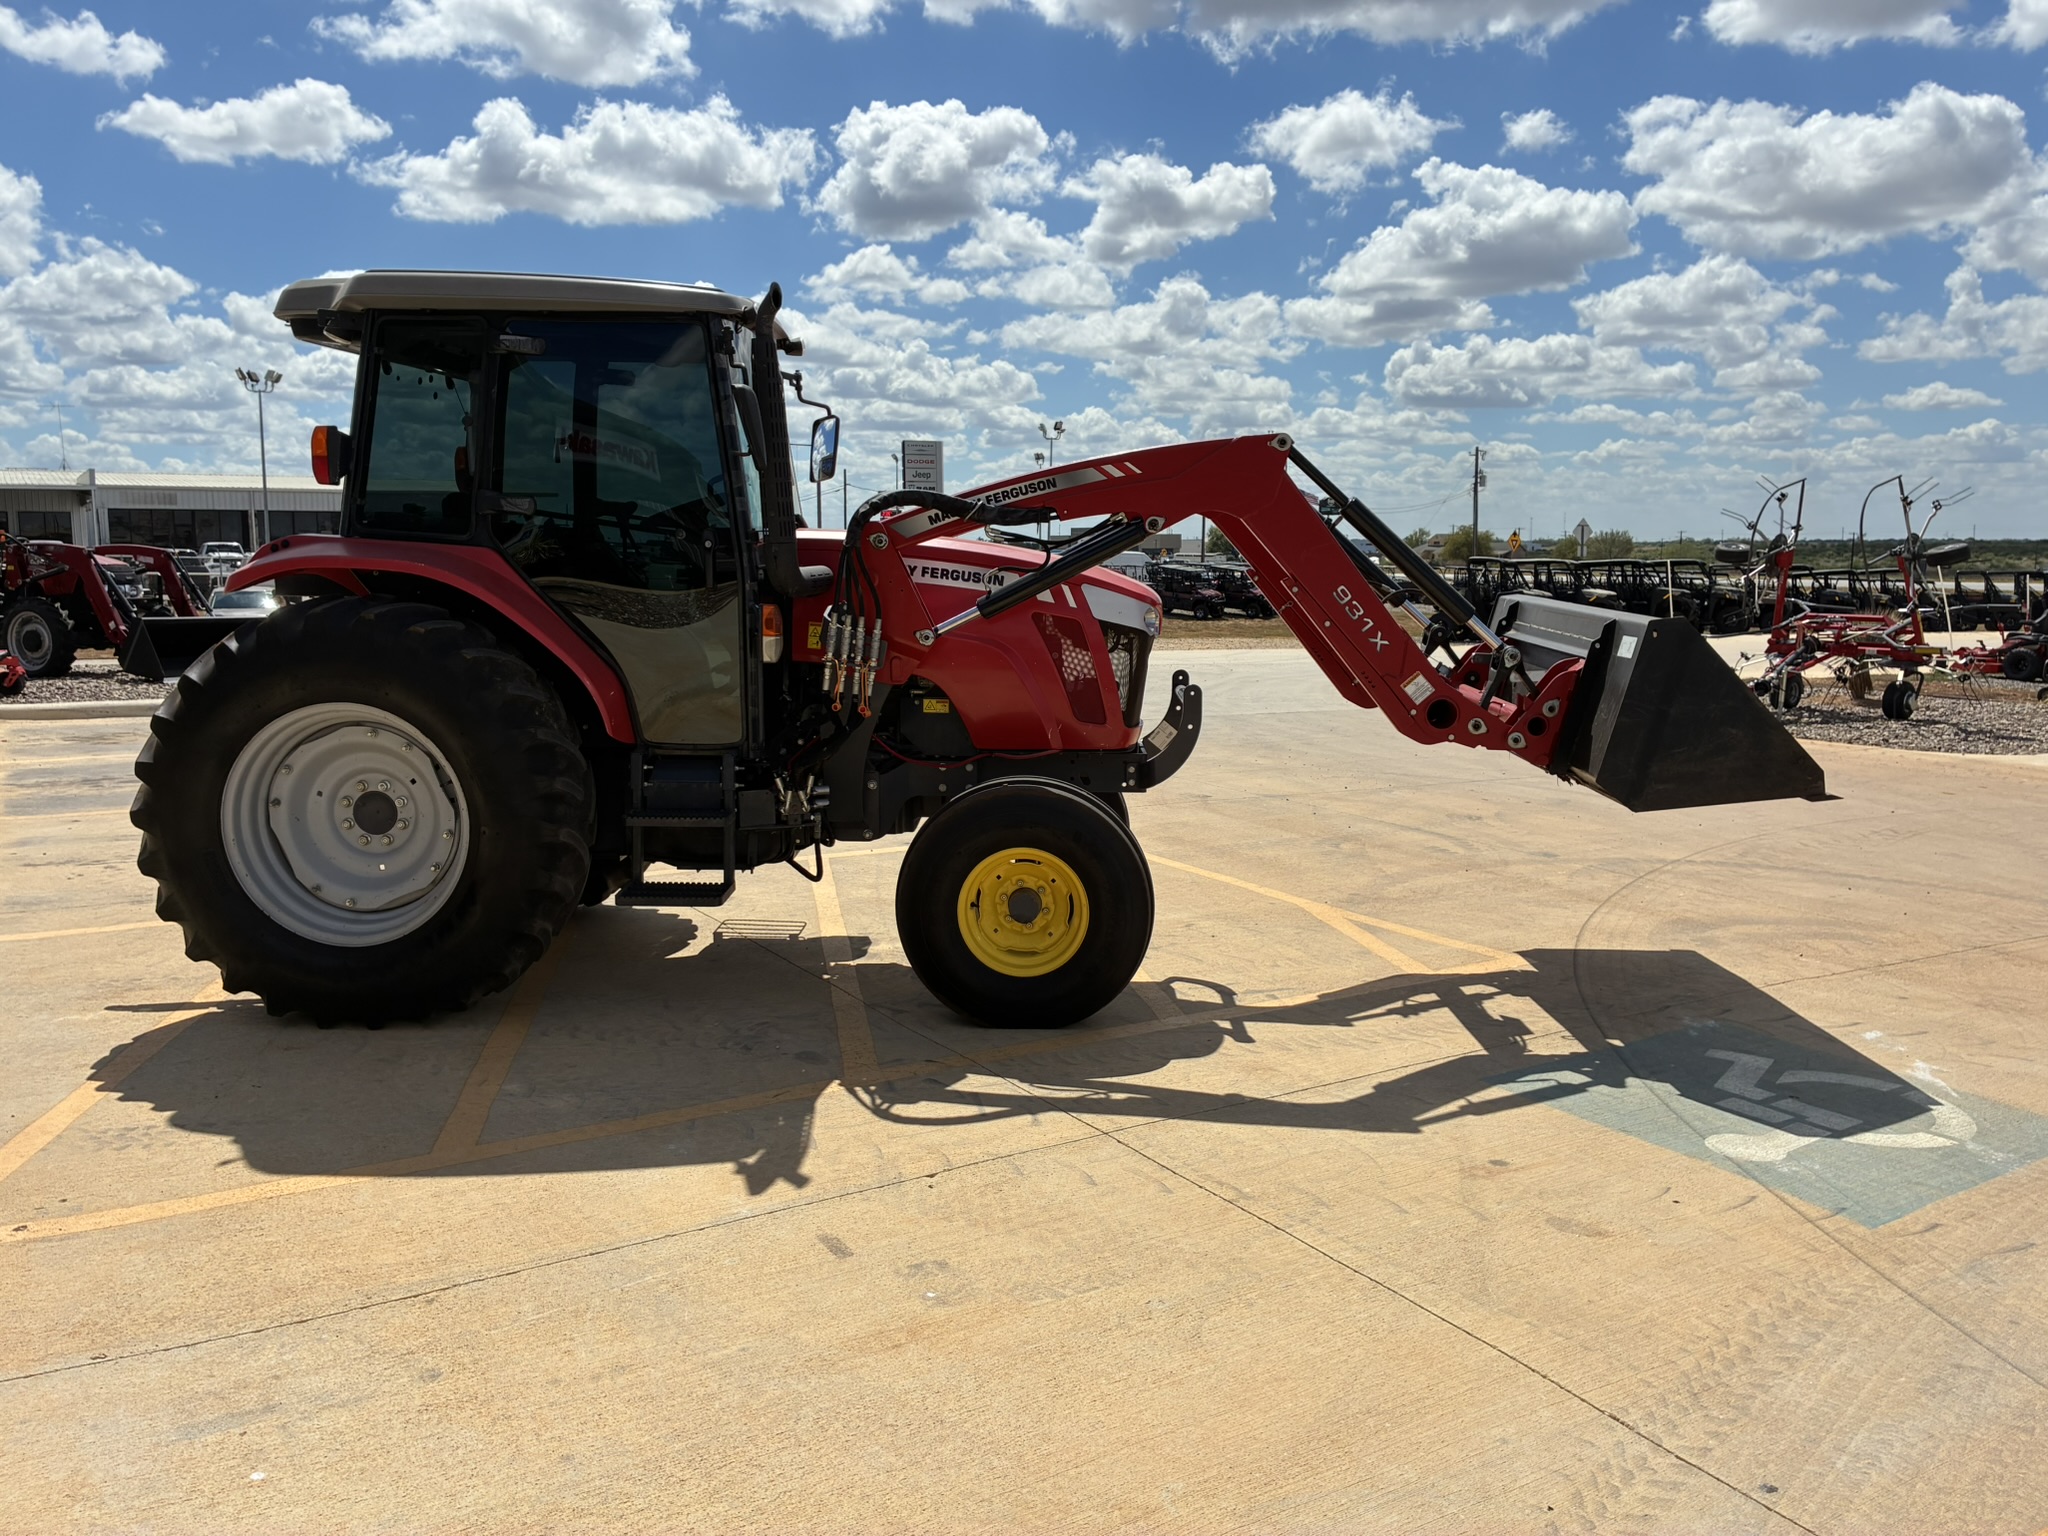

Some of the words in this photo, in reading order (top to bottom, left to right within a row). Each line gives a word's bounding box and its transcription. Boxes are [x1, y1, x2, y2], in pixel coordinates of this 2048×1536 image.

[912, 470, 932, 480] Jeep
[985, 477, 1058, 505] FERGUSON
[920, 565, 1005, 587] FERGUSON
